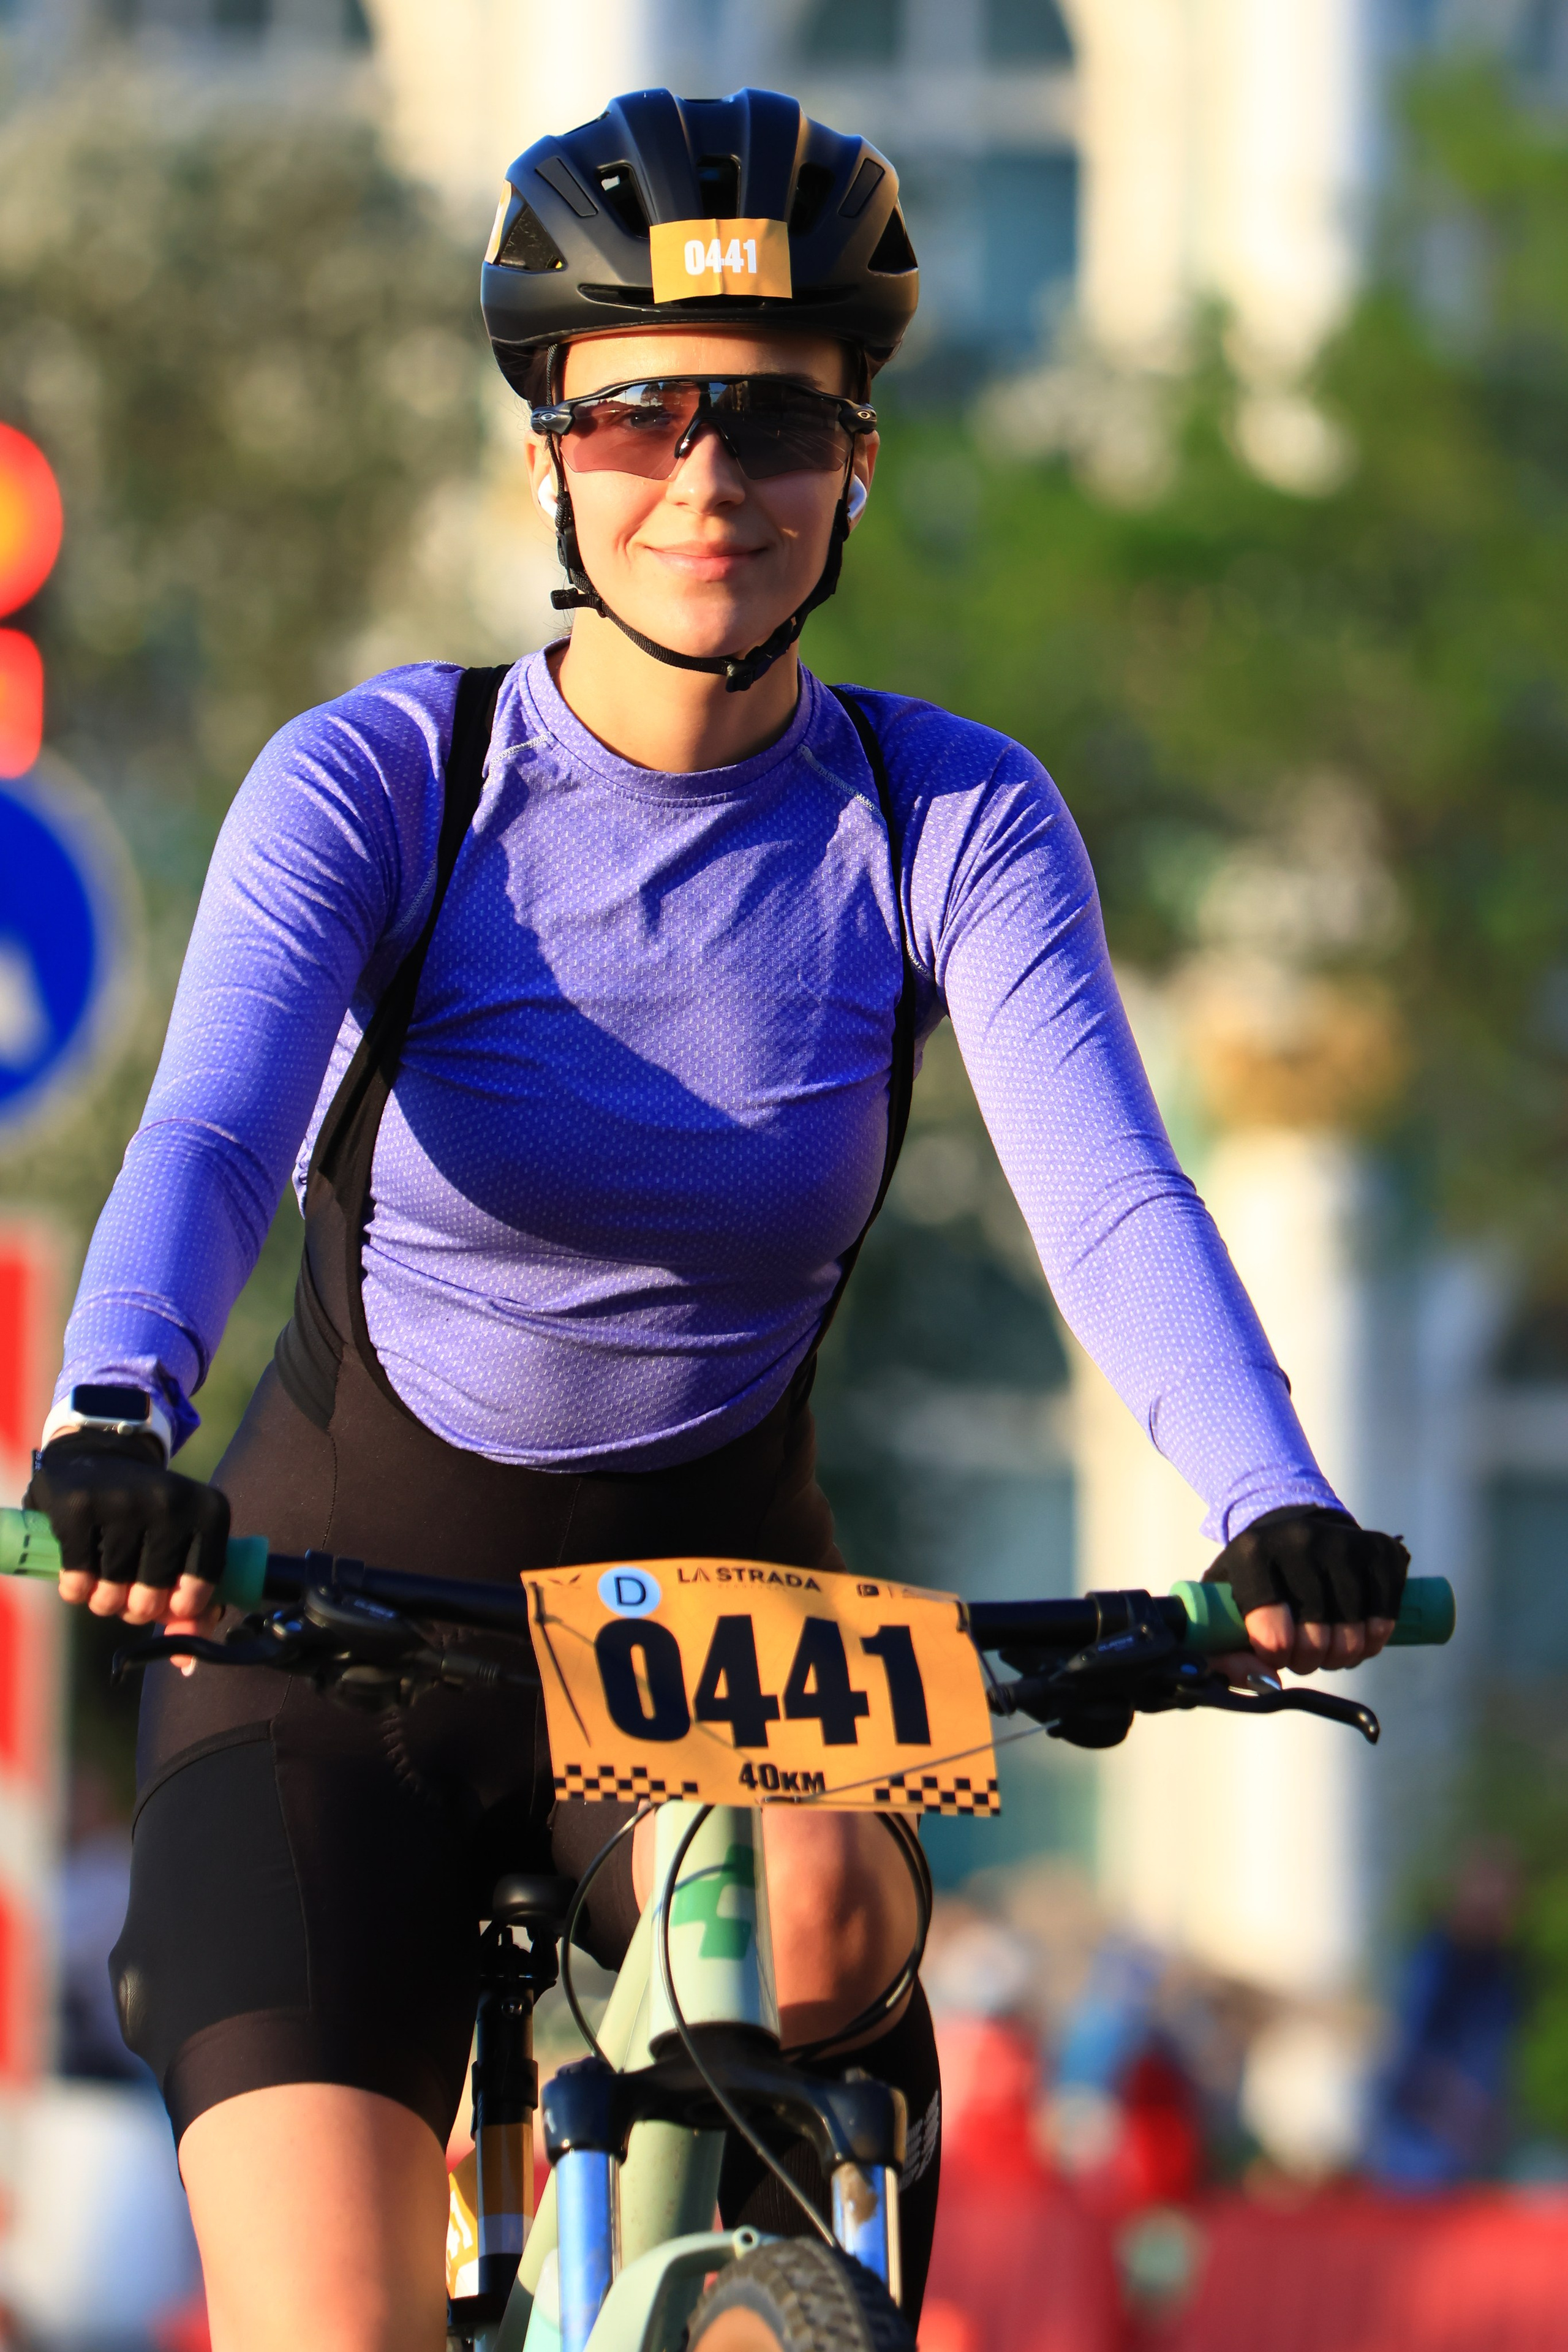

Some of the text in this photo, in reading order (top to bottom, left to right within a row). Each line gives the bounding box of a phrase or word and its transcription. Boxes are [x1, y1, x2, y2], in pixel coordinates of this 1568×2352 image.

[684, 238, 757, 275] 0441
[614, 1576, 647, 1607] D
[677, 1567, 710, 1583] LA
[716, 1567, 821, 1592] STRADA
[594, 1615, 932, 1749] 0441
